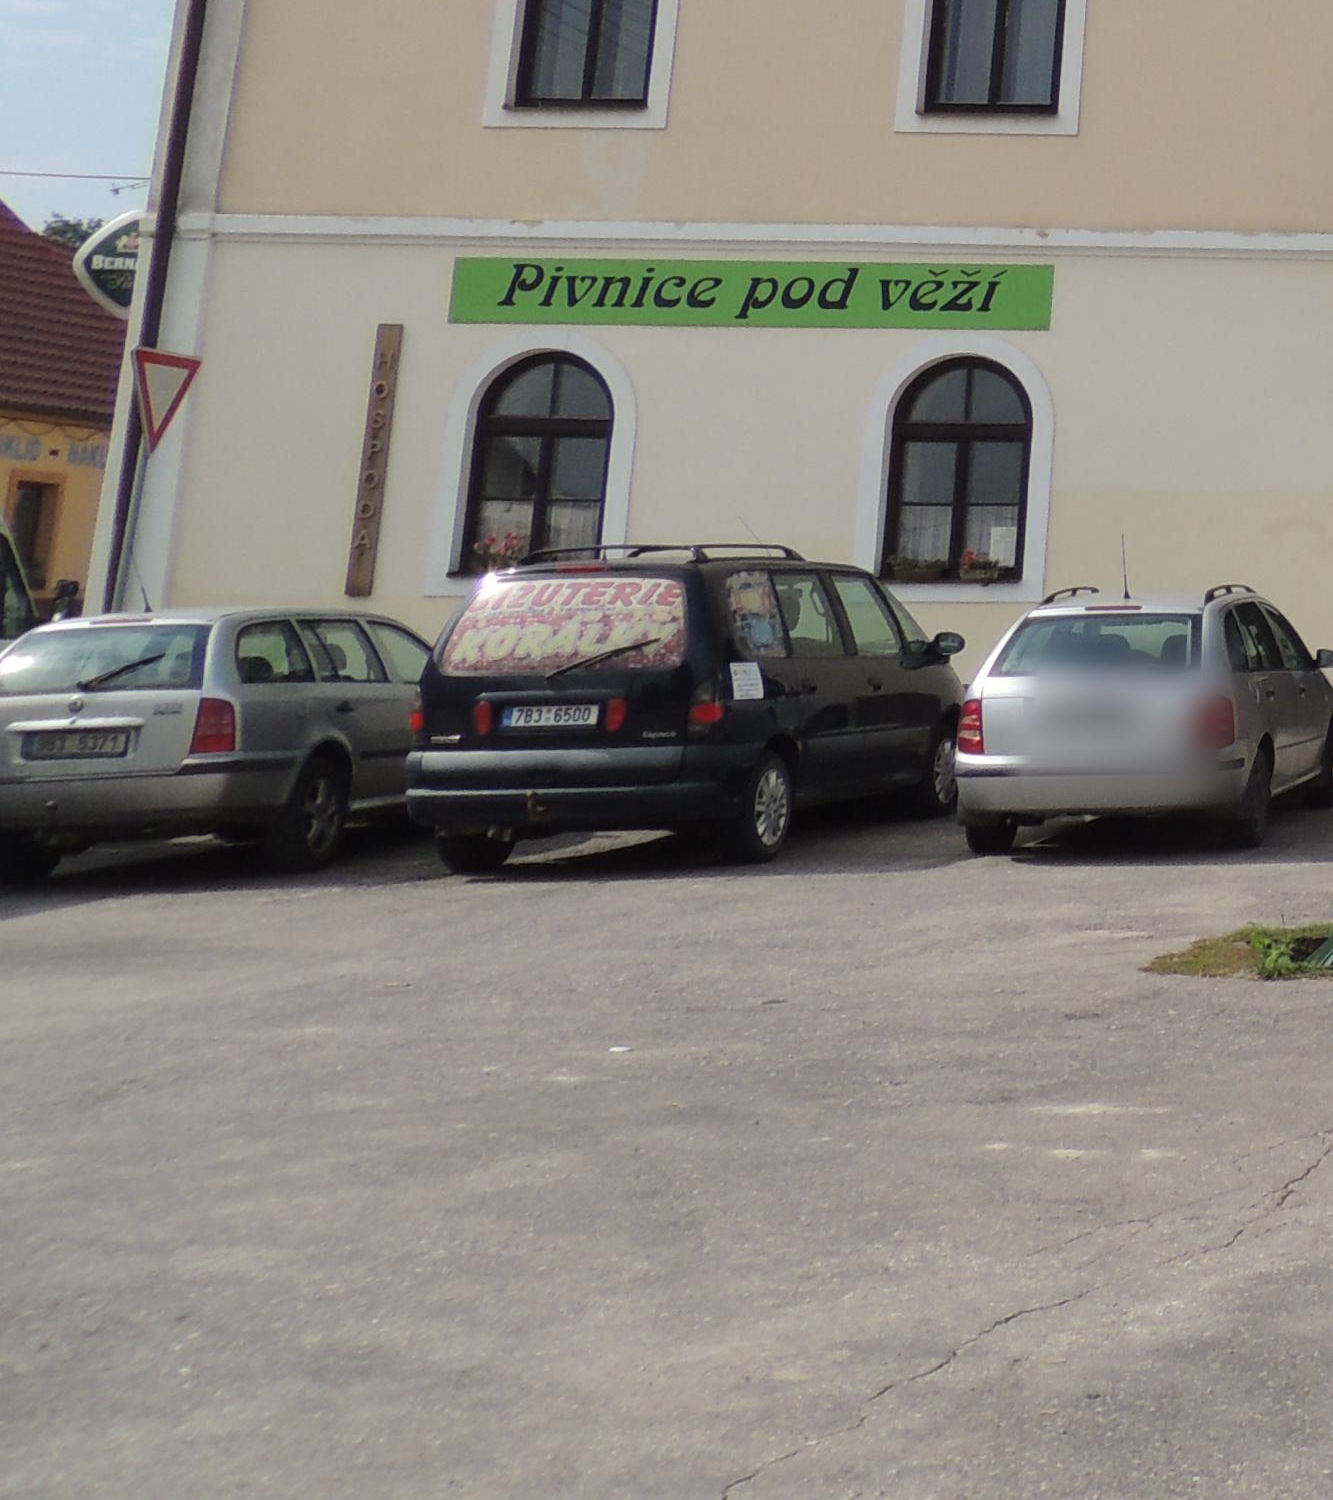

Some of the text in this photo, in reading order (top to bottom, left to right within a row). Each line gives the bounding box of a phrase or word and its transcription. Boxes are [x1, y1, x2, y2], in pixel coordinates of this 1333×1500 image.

[91, 254, 137, 271] BERN
[496, 262, 1008, 320] Pivnice pod věží
[353, 351, 397, 552] HOSPODA
[514, 706, 592, 725] 7B3 6500
